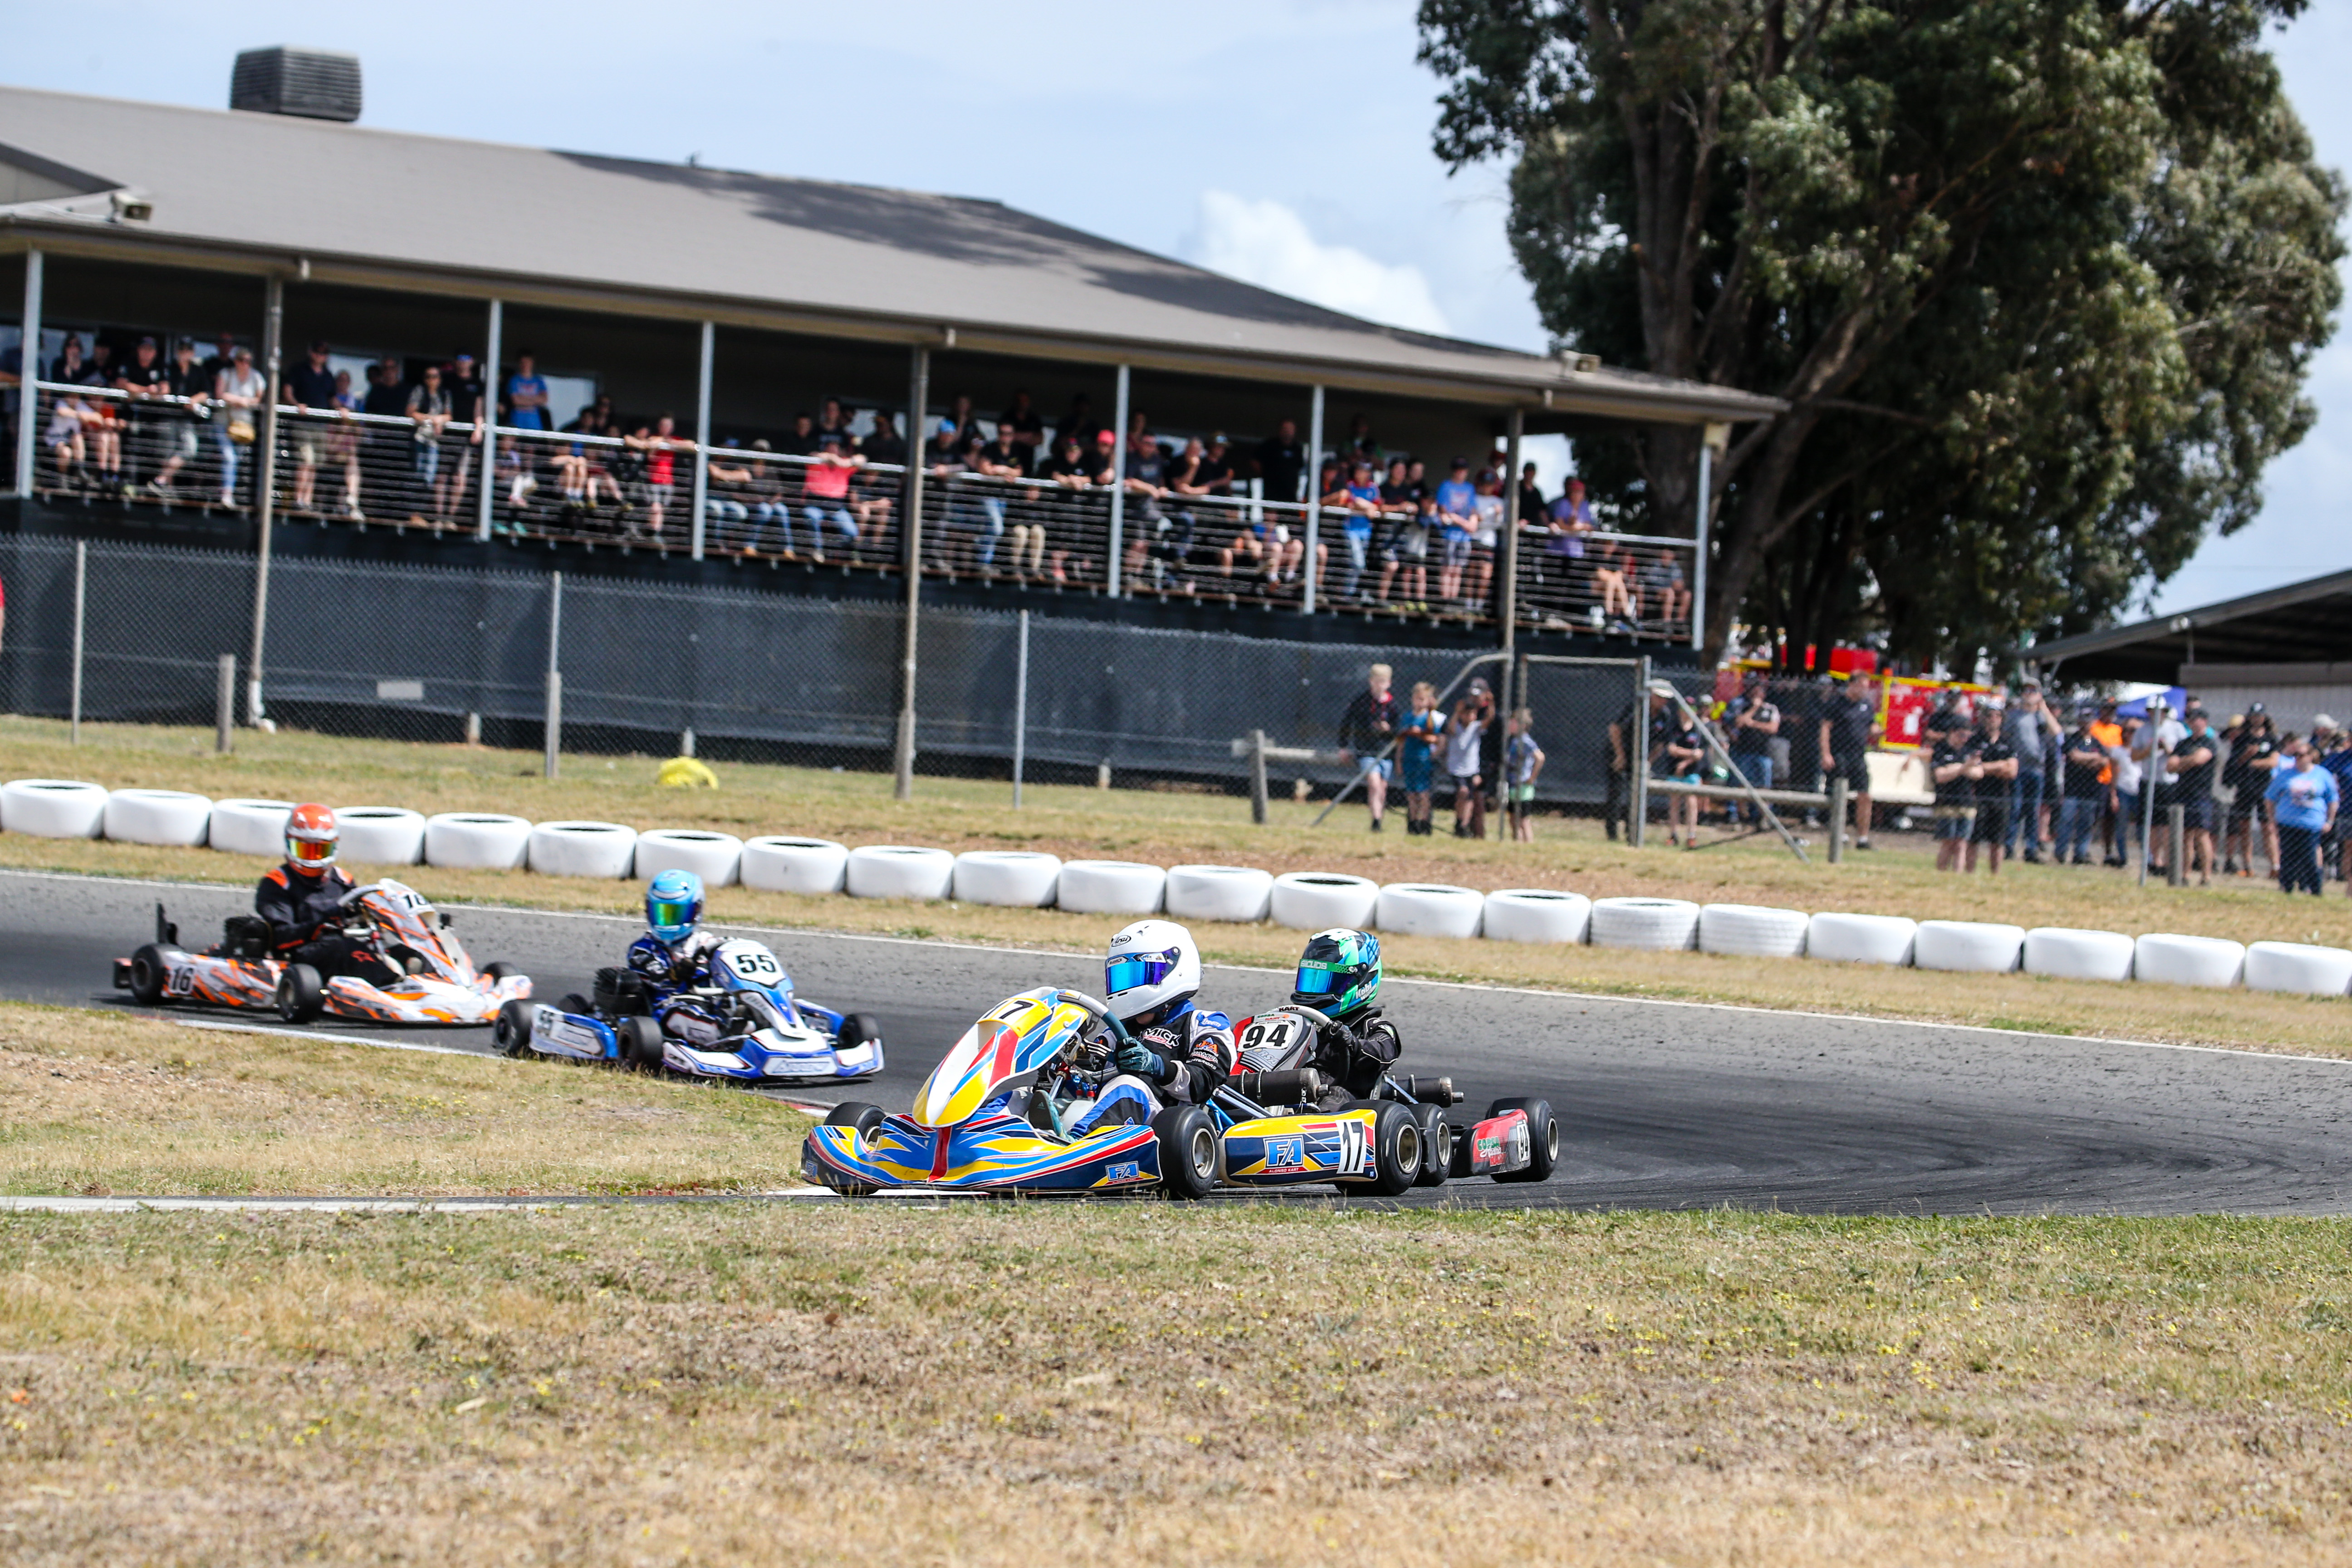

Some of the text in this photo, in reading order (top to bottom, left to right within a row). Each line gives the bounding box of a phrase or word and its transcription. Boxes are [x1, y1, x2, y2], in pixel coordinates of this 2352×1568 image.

[736, 954, 776, 973] 55
[172, 966, 192, 991] 16
[982, 1000, 1034, 1019] 17
[1243, 1024, 1289, 1049] 94
[1343, 1122, 1363, 1171] 17
